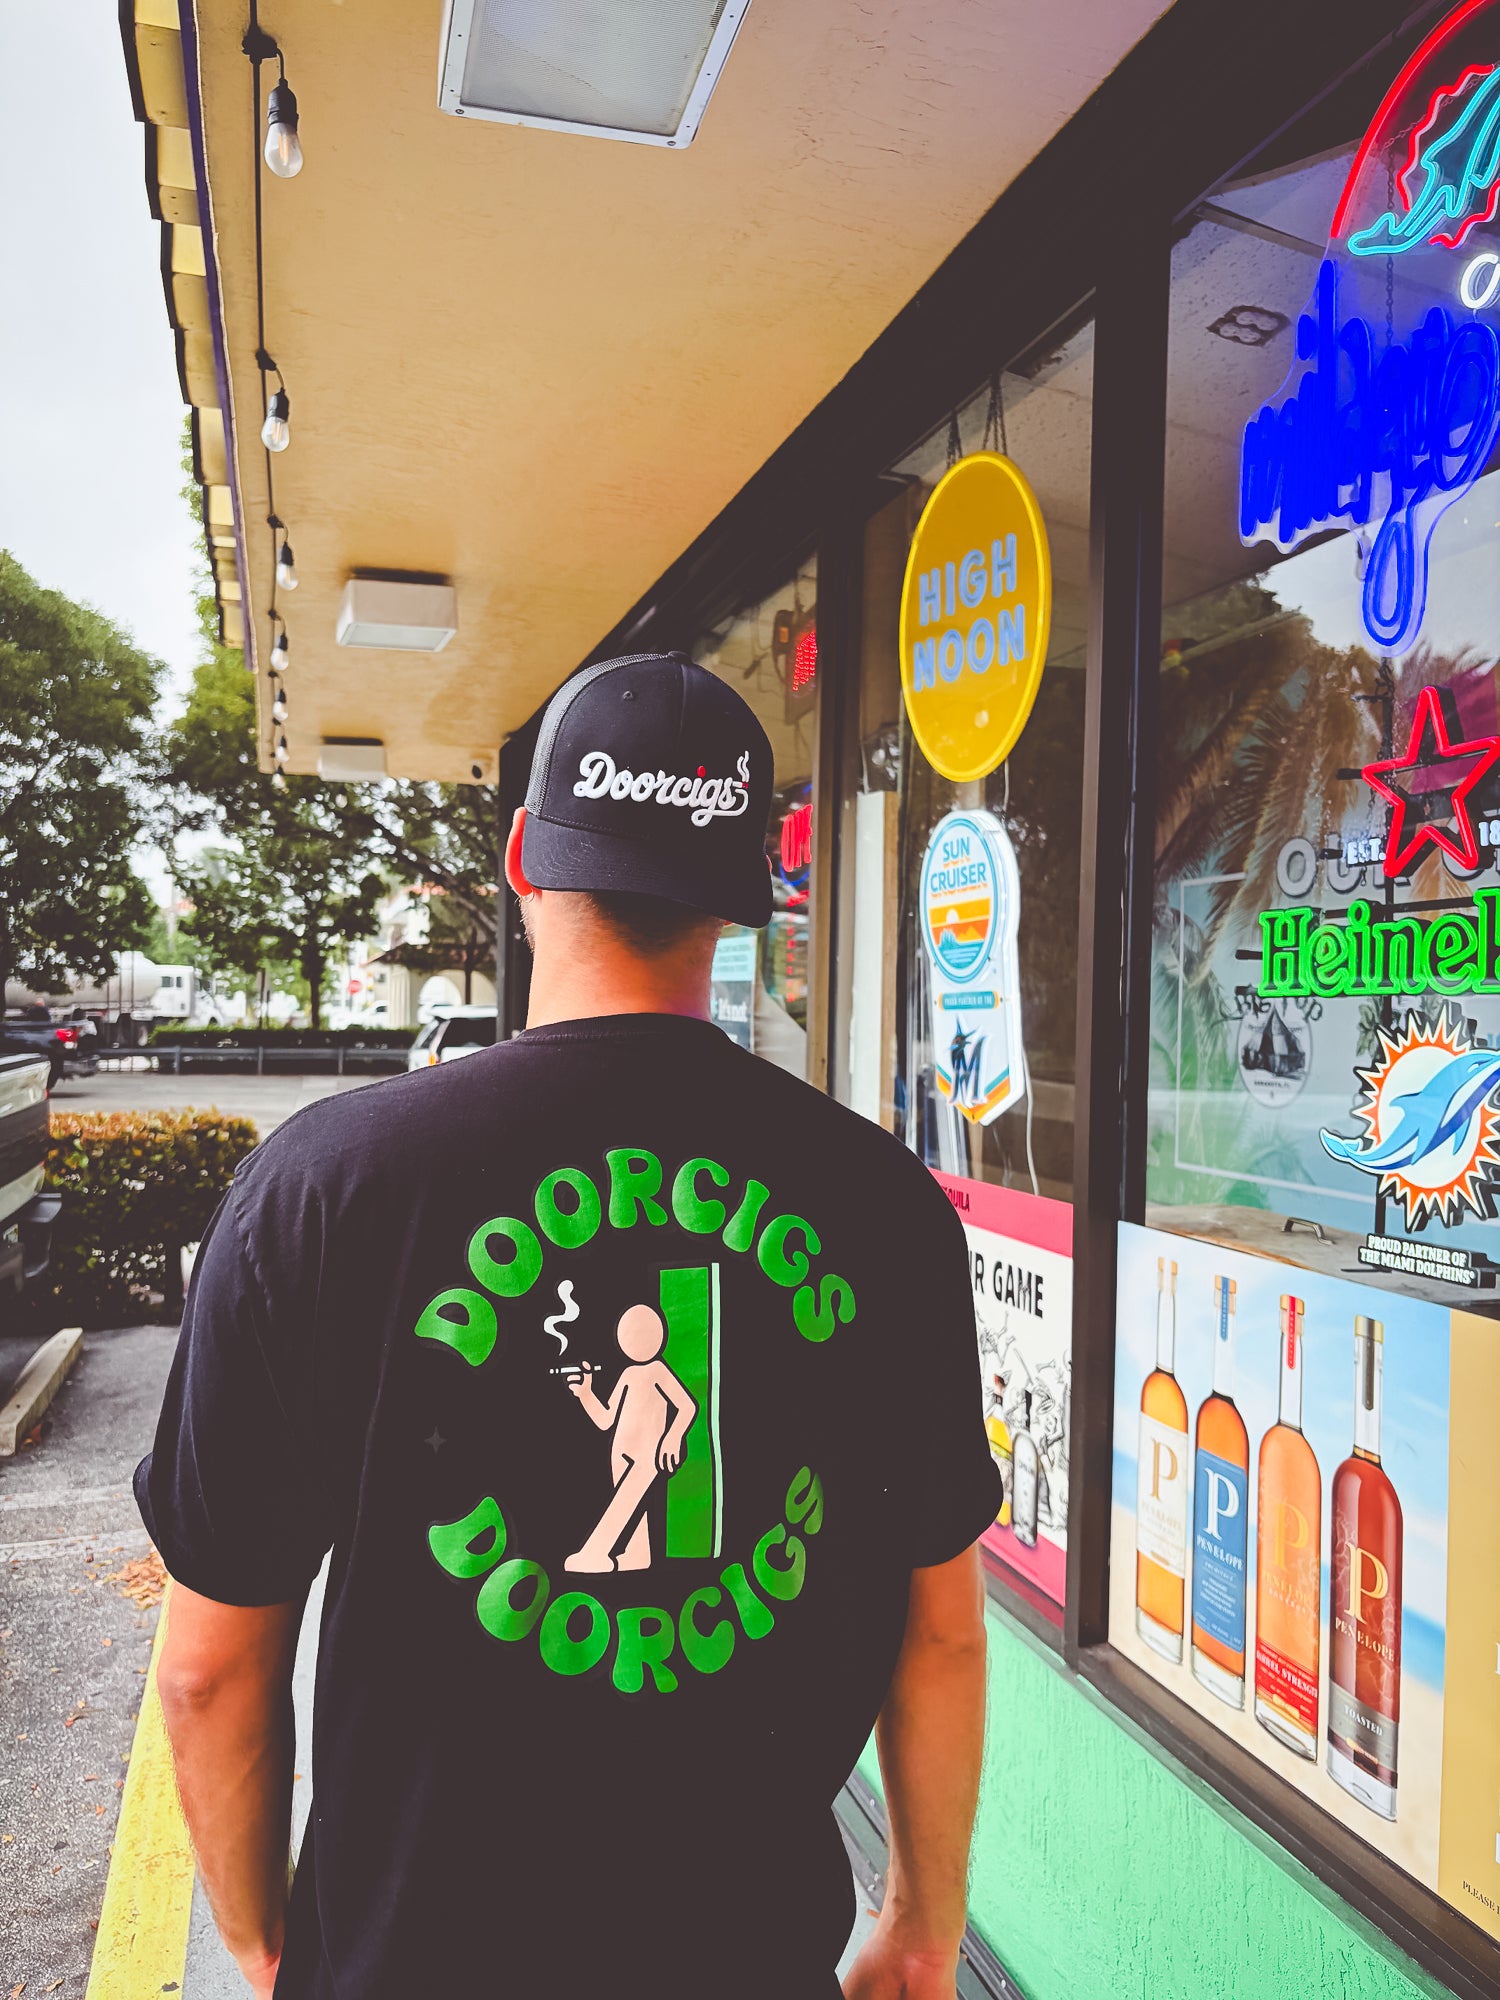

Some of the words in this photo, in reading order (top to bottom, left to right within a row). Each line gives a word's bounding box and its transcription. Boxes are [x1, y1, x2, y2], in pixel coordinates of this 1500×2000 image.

[919, 533, 1017, 627] HIGH
[914, 603, 1026, 692] NOON
[573, 751, 749, 827] Doorcigs
[930, 862, 987, 892] CRUISER
[943, 836, 970, 862] SUN
[414, 1148, 857, 1367] DOORCIGS
[1360, 1248, 1380, 1264] THE
[1381, 1253, 1416, 1272] MIAMI
[1368, 1235, 1401, 1252] PROUD
[1402, 1241, 1451, 1264] PARTNER
[1451, 1252, 1468, 1267] OF
[993, 1261, 1044, 1318] GAME
[1152, 1437, 1178, 1501] P
[1204, 1467, 1240, 1541] P
[1272, 1502, 1309, 1571] P
[428, 1466, 824, 1694] DOORCIGS
[1344, 1541, 1389, 1624] P
[1335, 1617, 1395, 1662] PENELOPE
[1344, 1705, 1383, 1736] TOASTED
[1463, 1880, 1495, 1911] PLEASE
